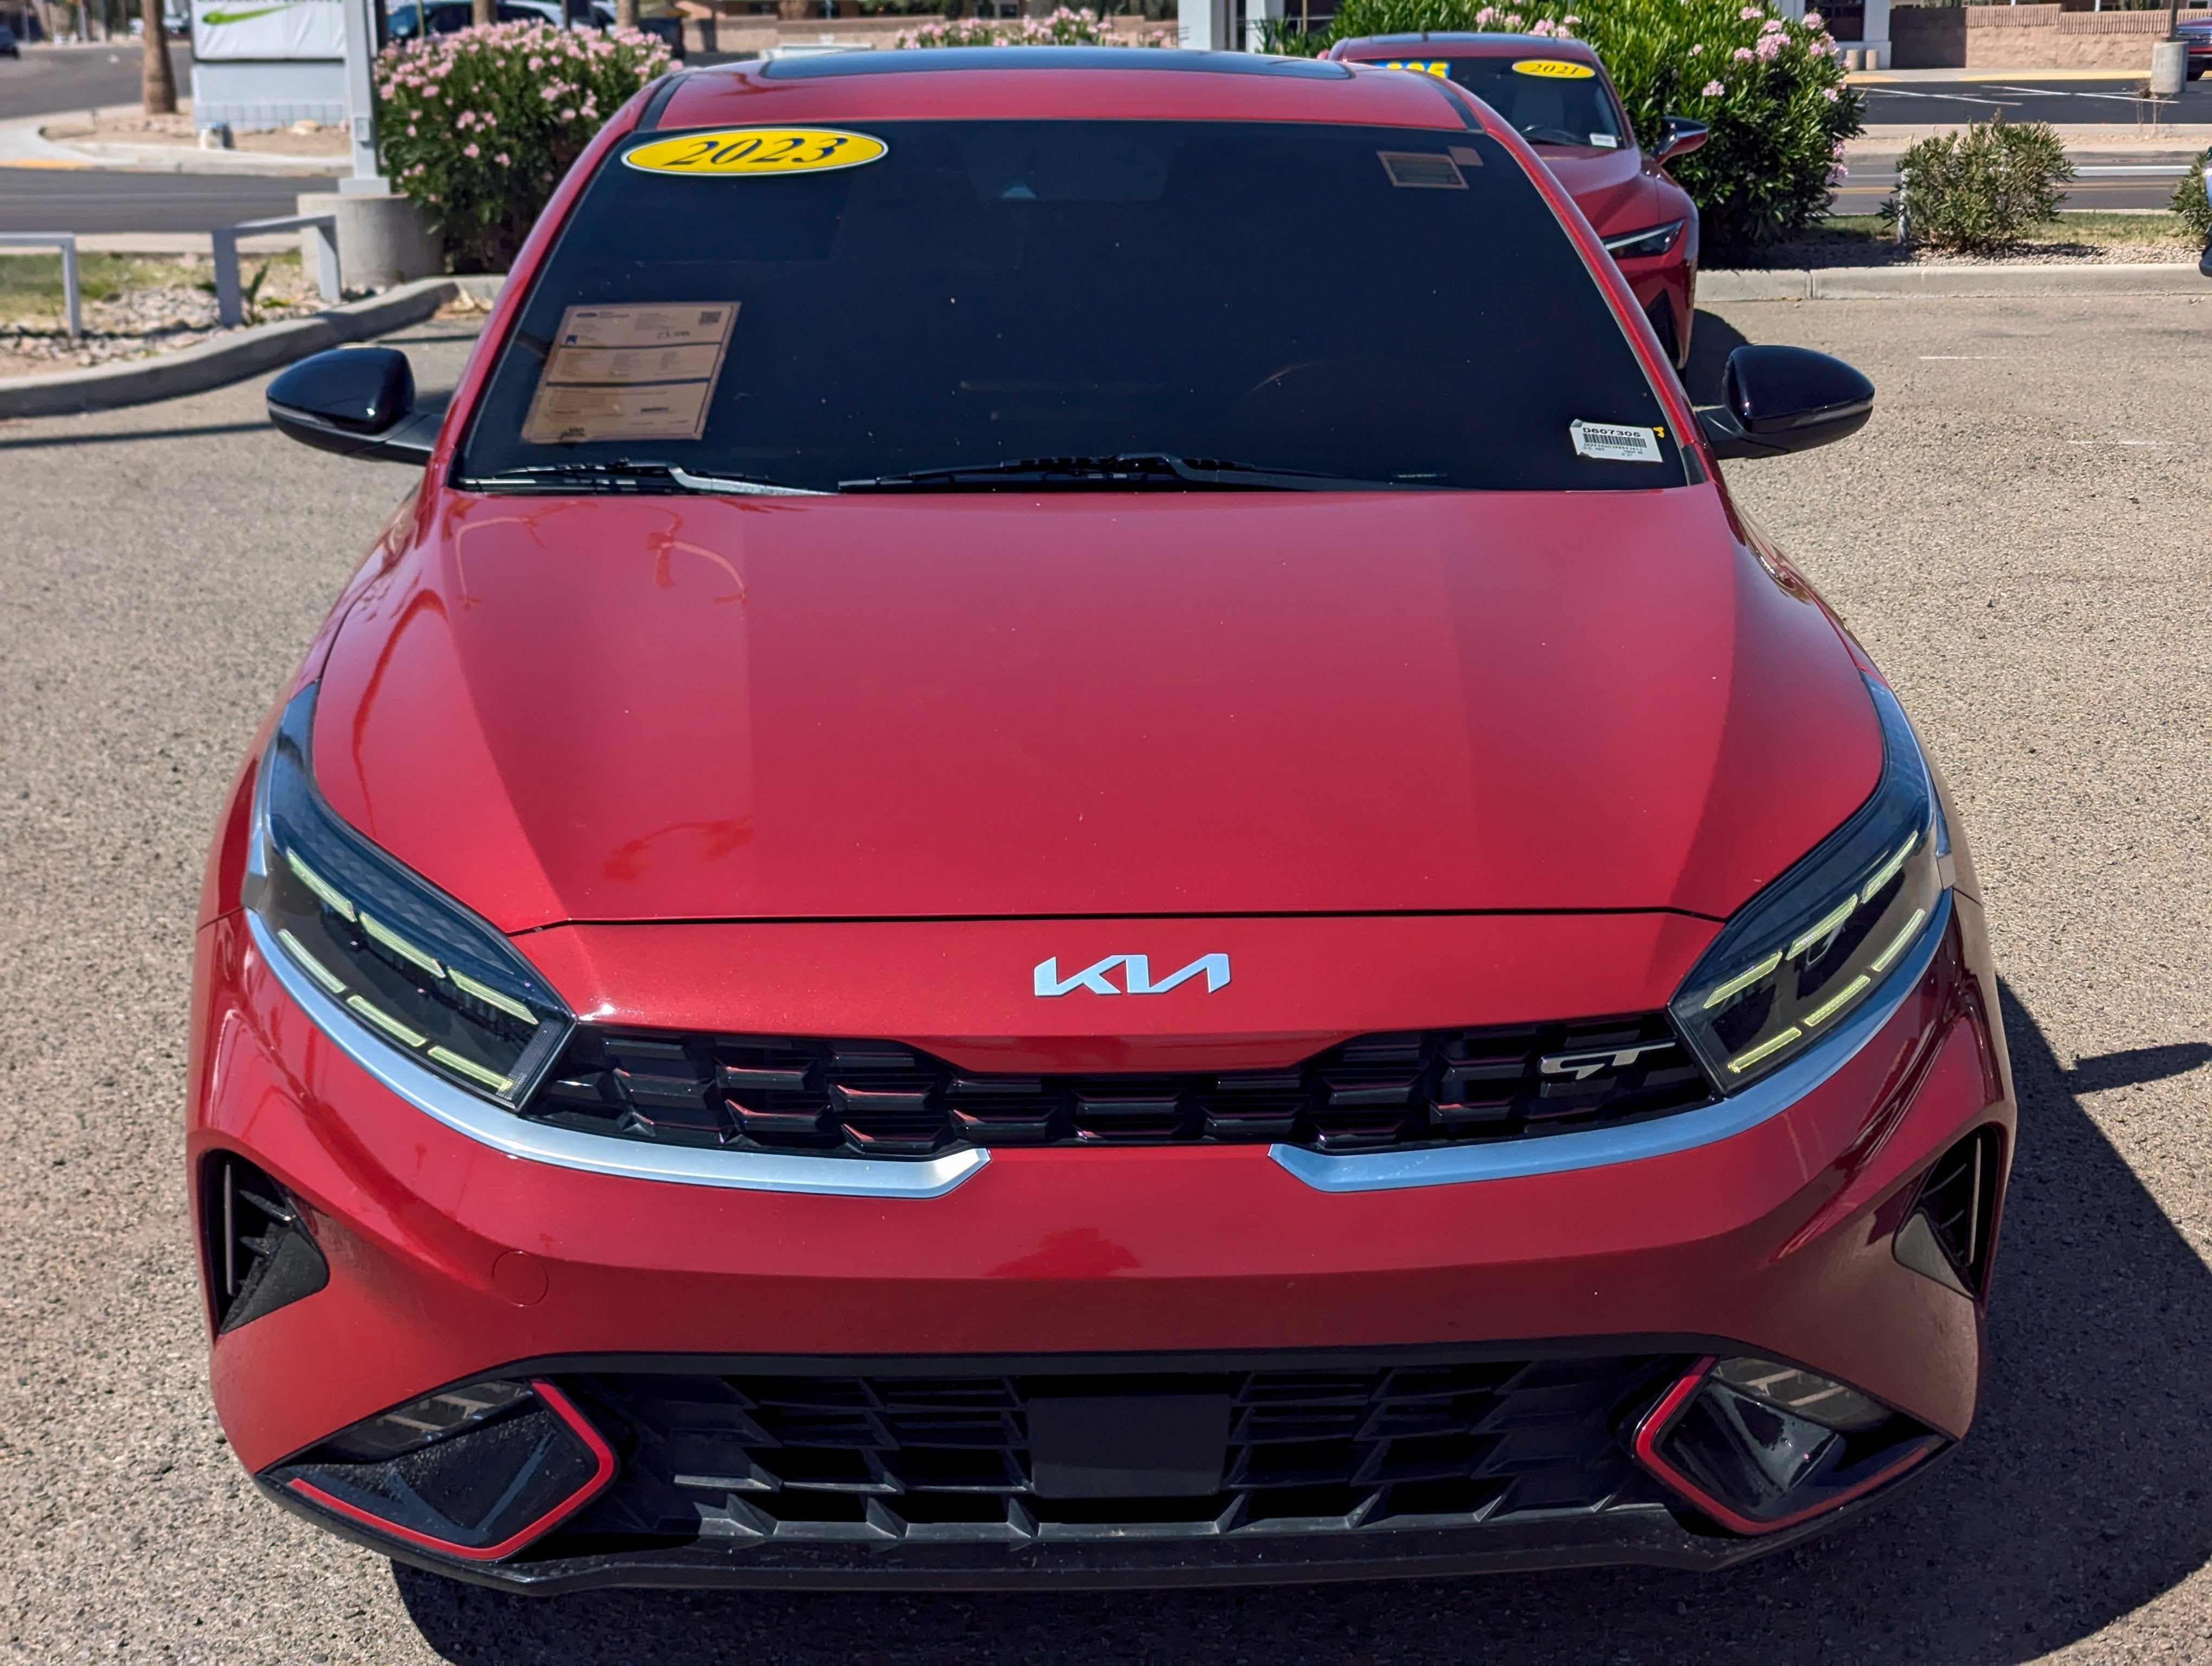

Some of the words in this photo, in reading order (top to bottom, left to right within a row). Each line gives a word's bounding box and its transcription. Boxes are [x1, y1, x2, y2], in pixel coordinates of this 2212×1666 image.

[1529, 64, 1579, 75] 2021
[661, 137, 849, 166] 2023
[1034, 953, 1231, 997] KIA
[1540, 1042, 1676, 1080] GT
